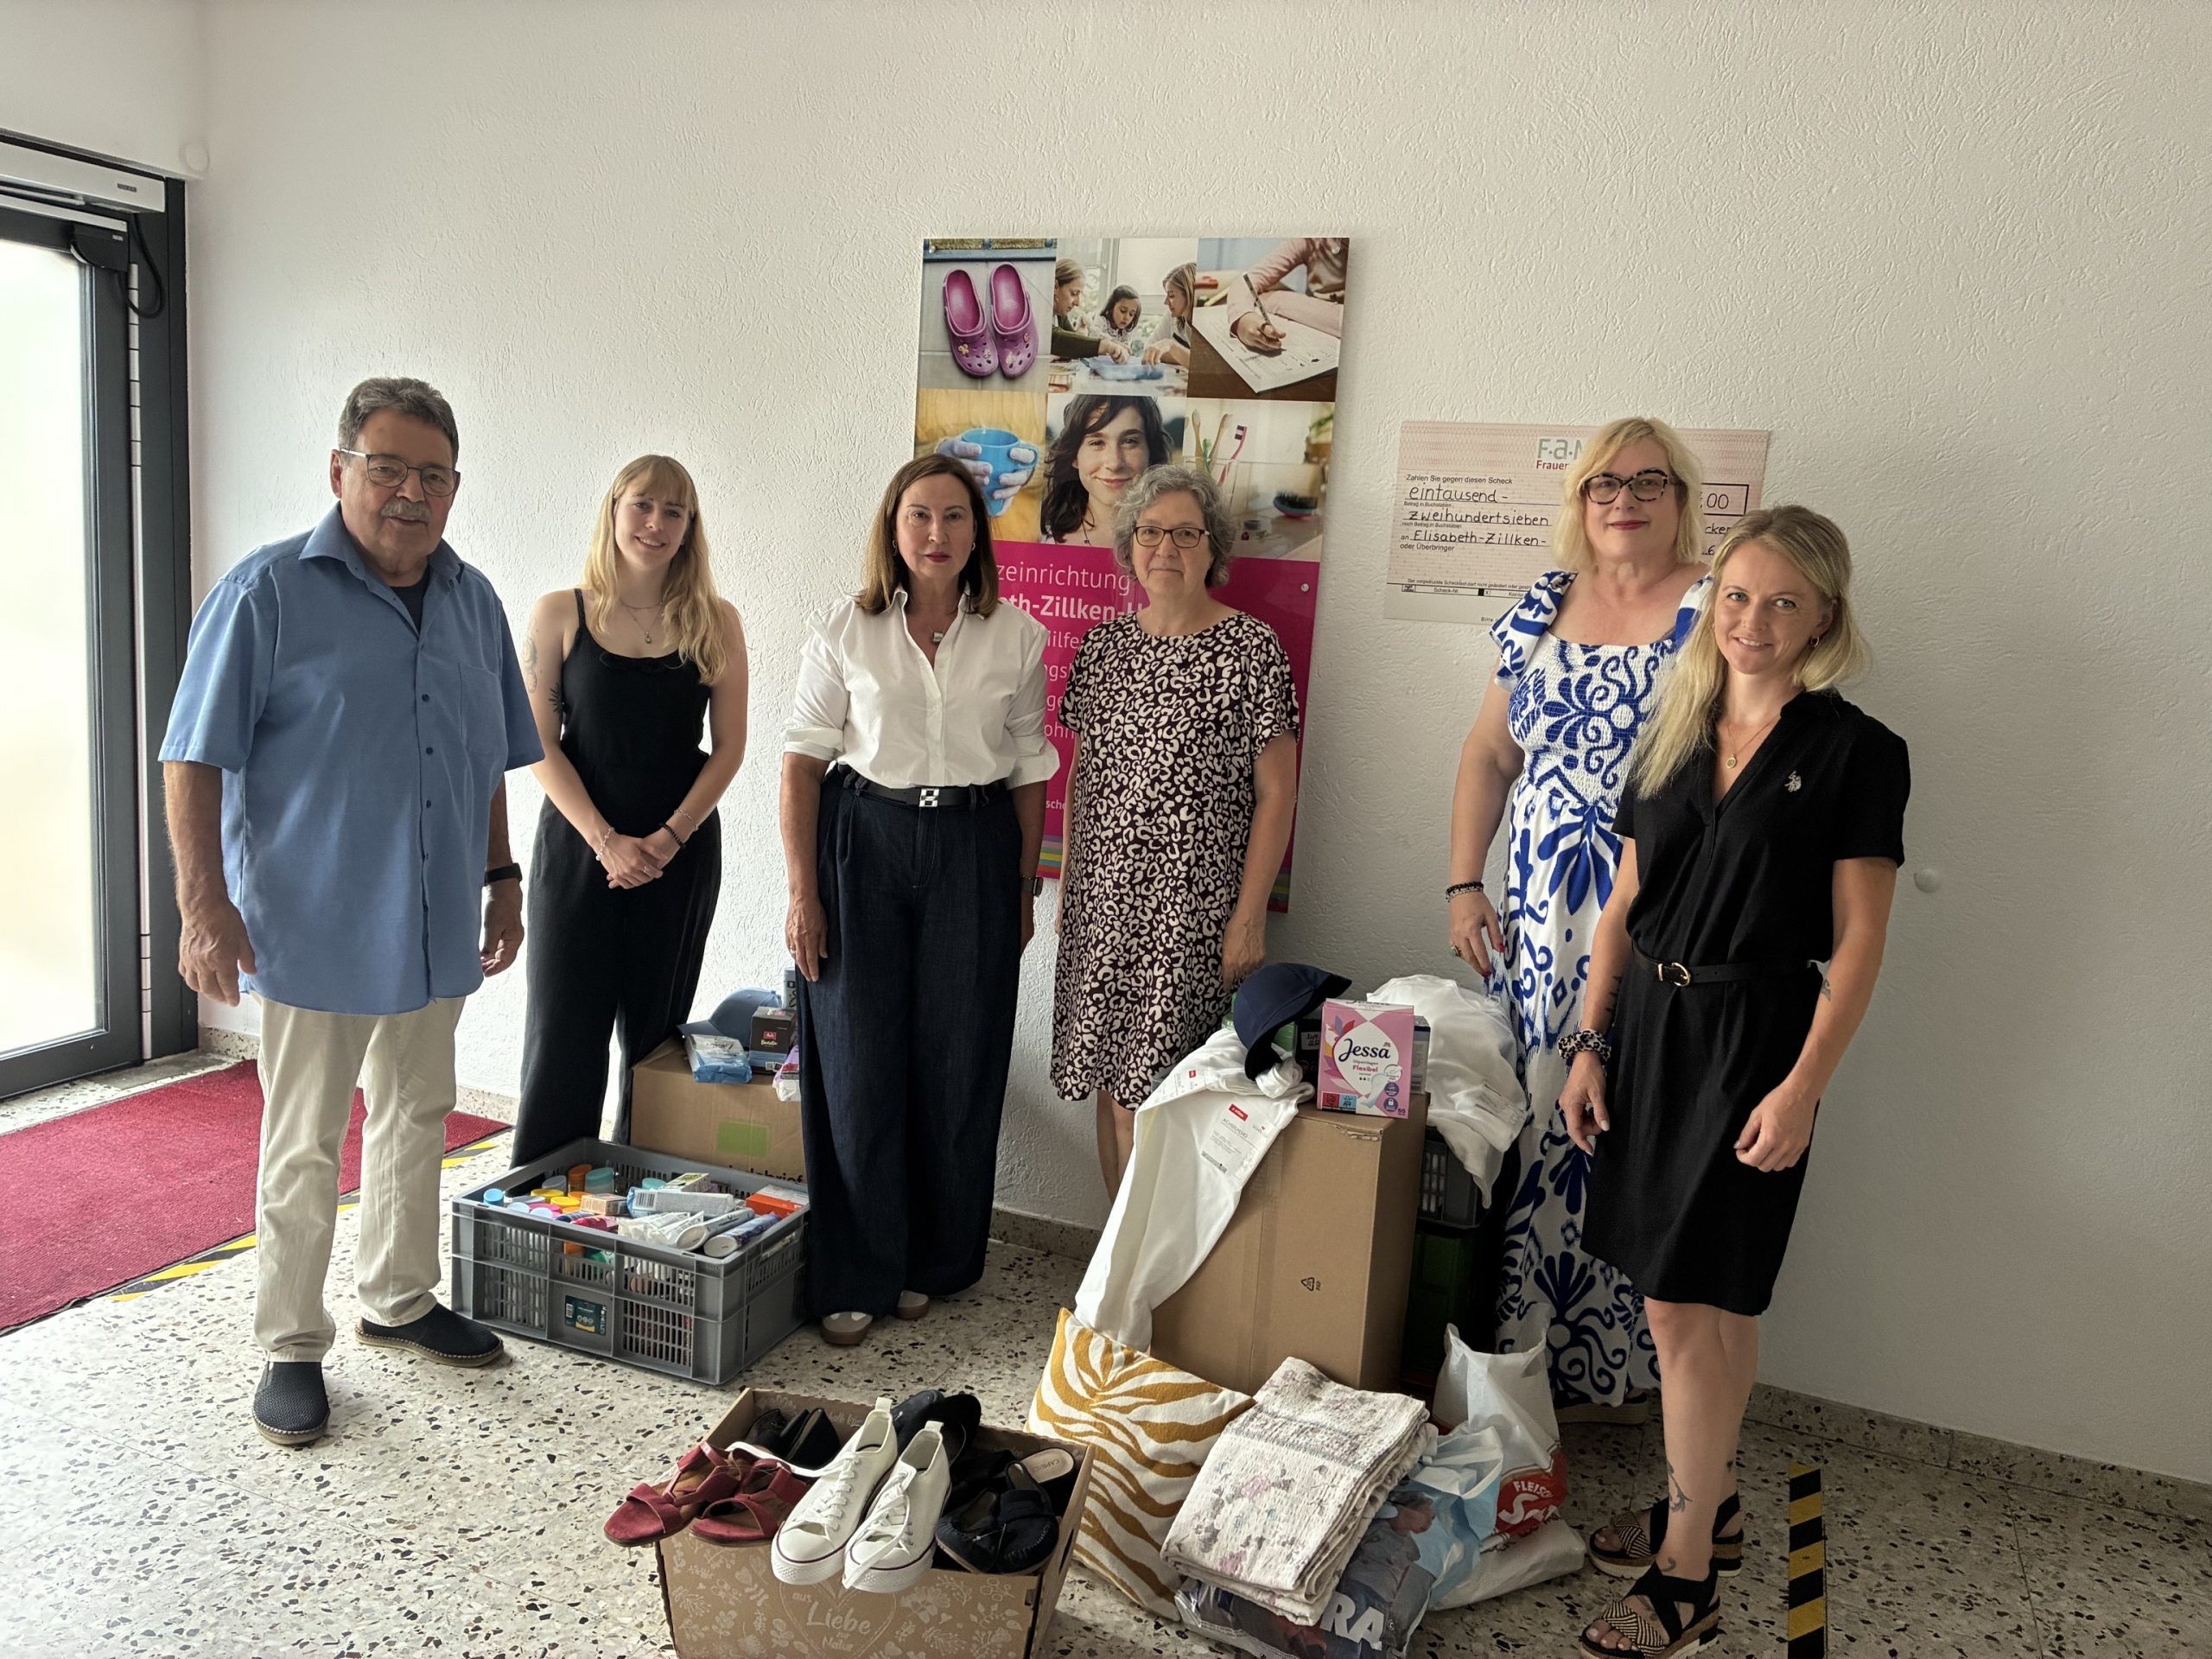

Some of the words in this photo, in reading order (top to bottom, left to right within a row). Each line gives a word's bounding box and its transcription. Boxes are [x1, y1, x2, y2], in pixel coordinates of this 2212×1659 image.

[1464, 475, 1486, 484] diesen
[1416, 543, 1455, 552] Überbringer
[996, 562, 1130, 596] zeinrichtung
[1338, 1038, 1391, 1062] Jessa
[792, 1592, 812, 1603] aus
[806, 1601, 871, 1635] Liebe
[822, 1635, 854, 1652] Natur
